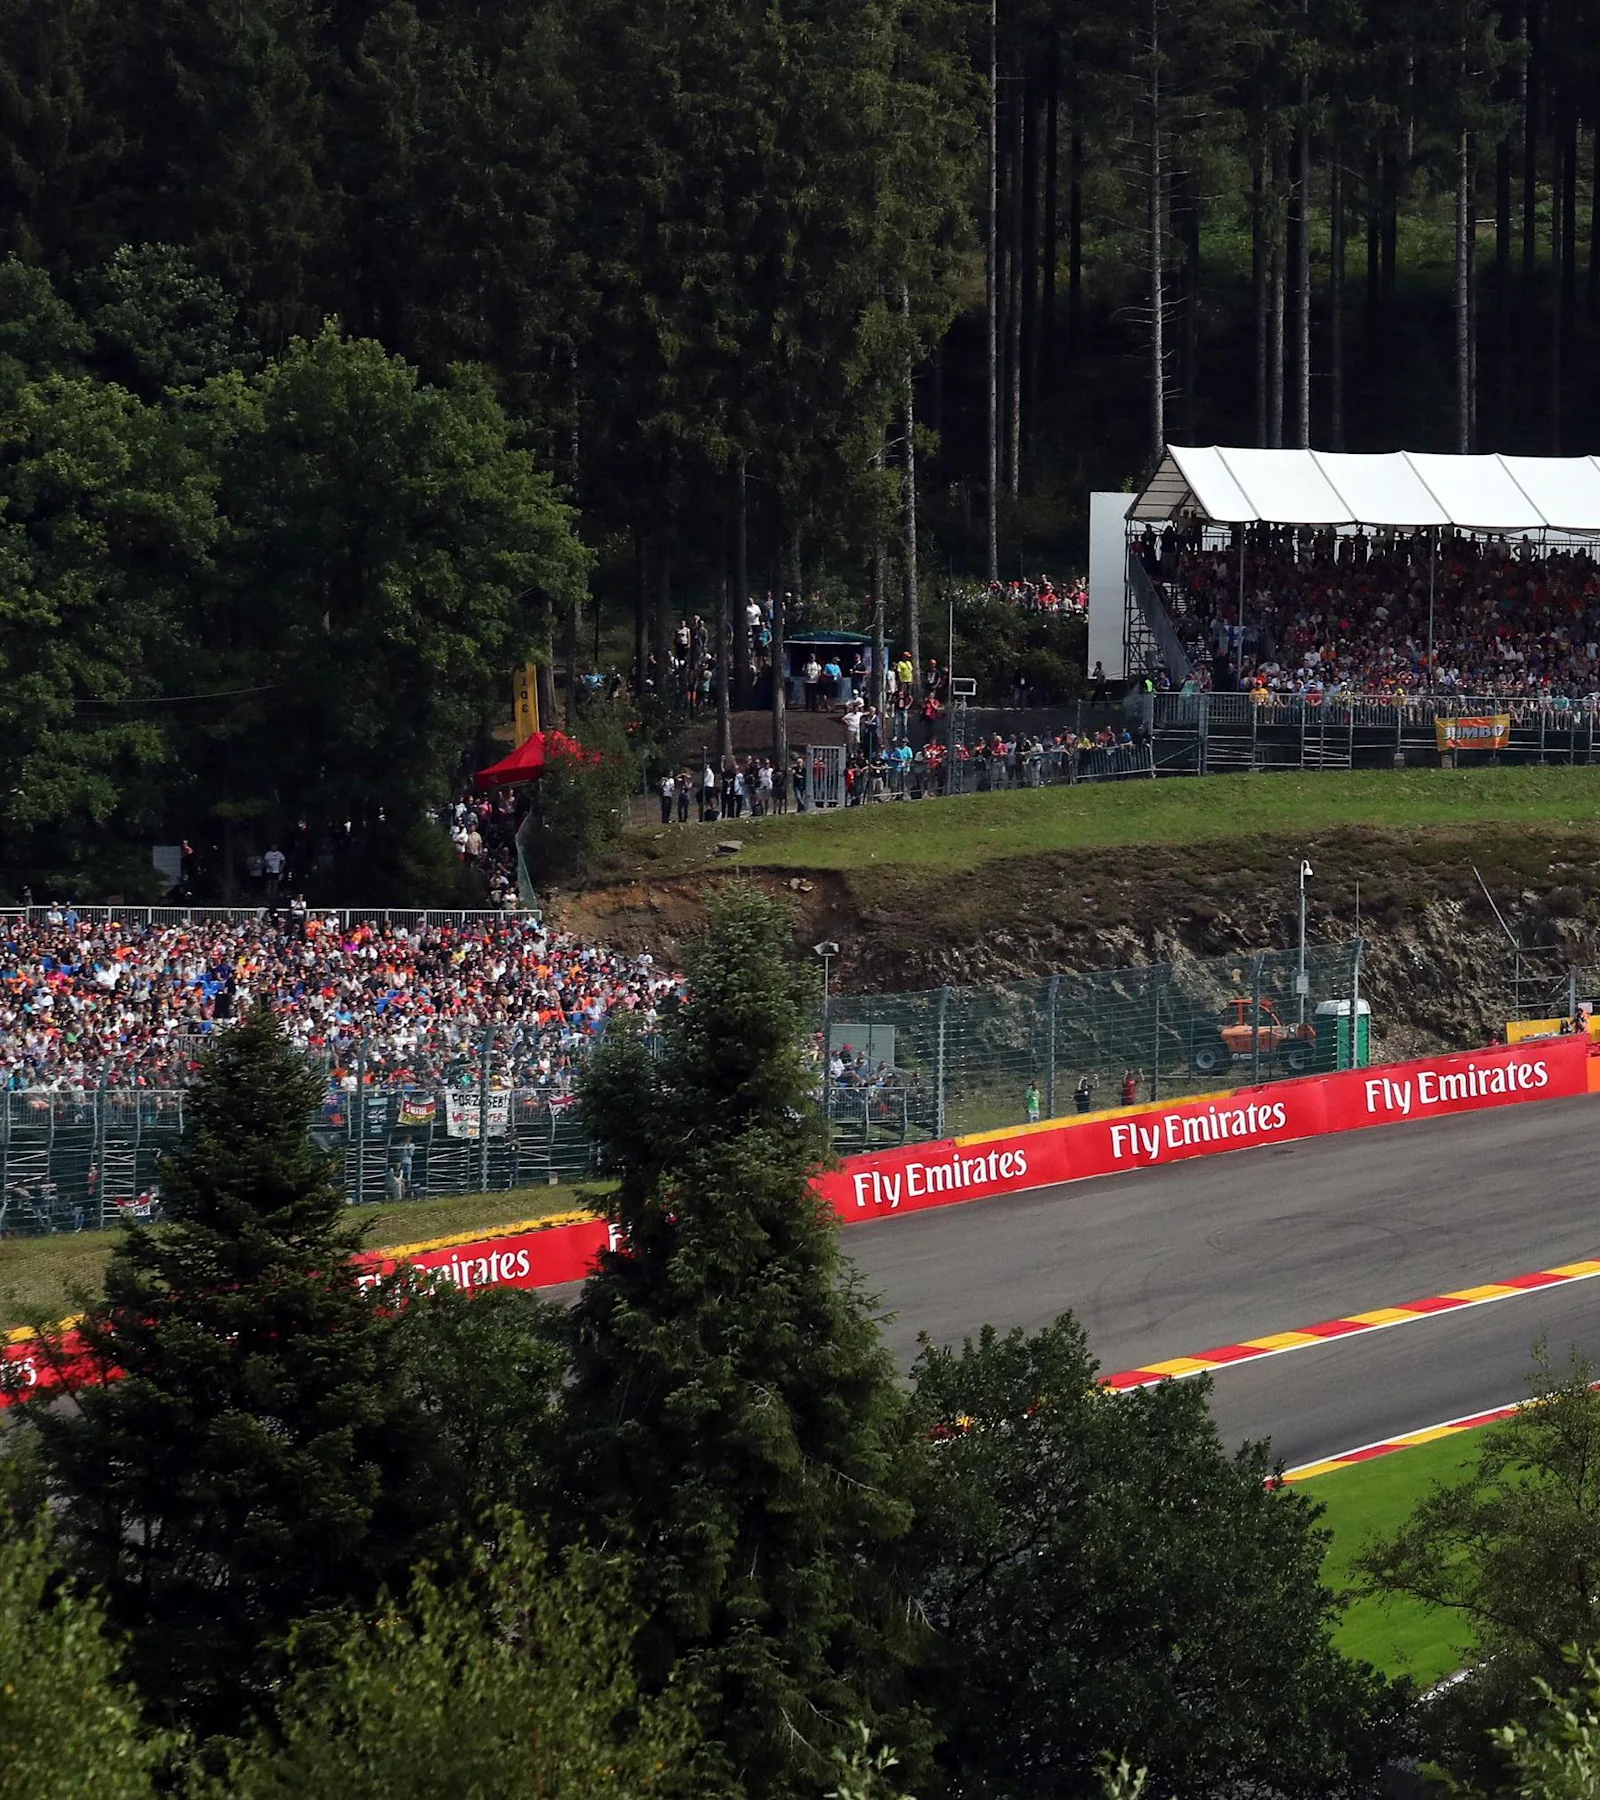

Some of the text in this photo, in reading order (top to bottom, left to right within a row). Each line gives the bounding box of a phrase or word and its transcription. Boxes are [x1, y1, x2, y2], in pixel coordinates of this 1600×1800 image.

[1444, 724, 1506, 740] JUMBO
[452, 1093, 481, 1107] FORZ
[1364, 1060, 1548, 1115] Fly Emirates
[1109, 1102, 1287, 1160] Fly Emirates
[852, 1149, 1028, 1208] Fly Emirates
